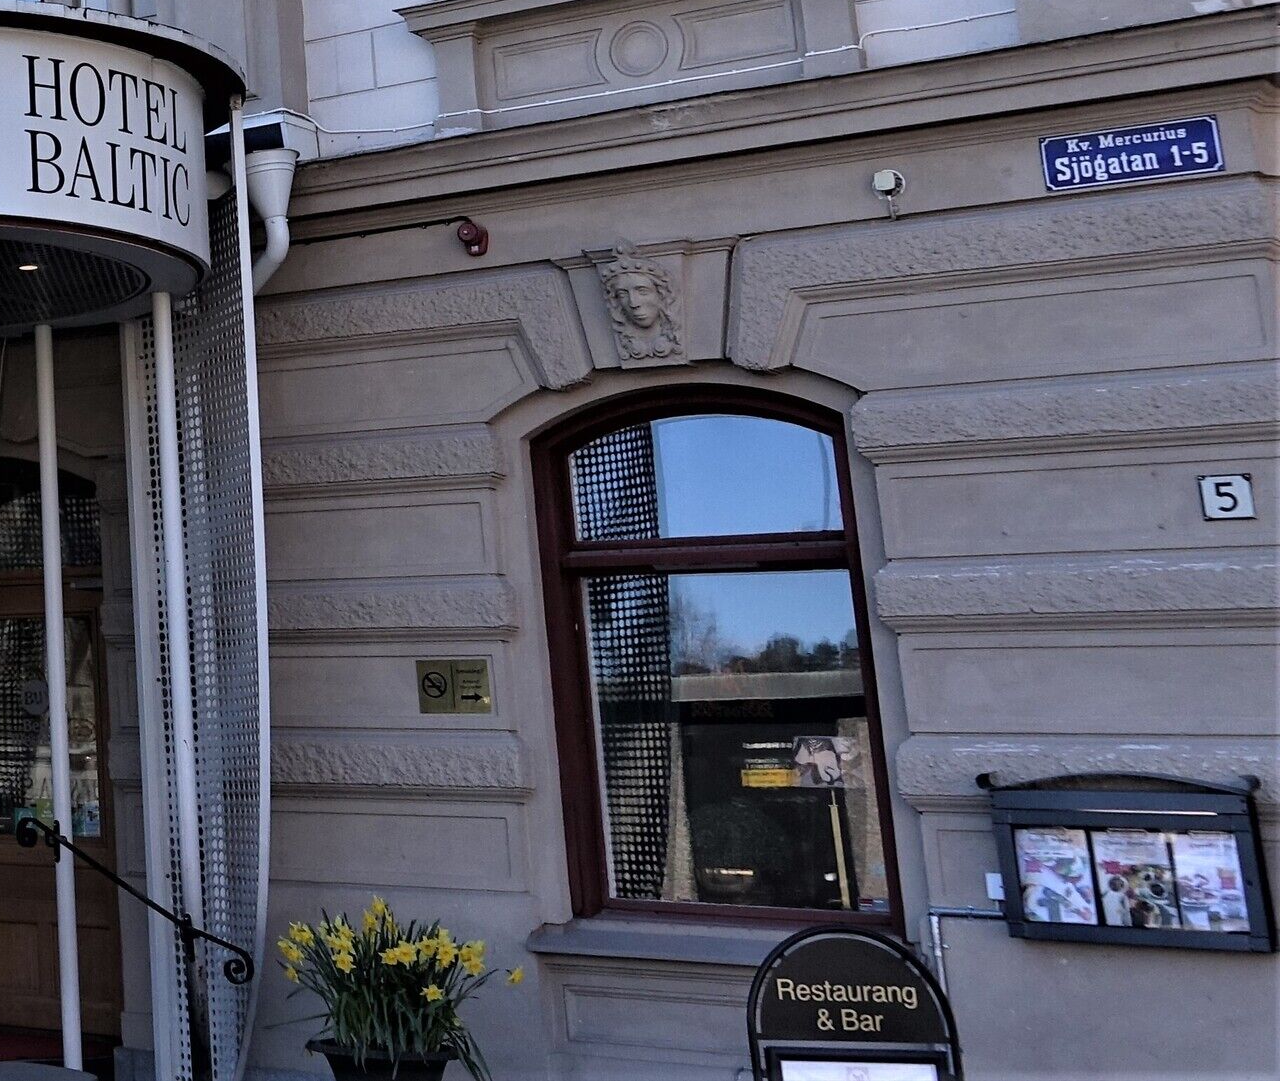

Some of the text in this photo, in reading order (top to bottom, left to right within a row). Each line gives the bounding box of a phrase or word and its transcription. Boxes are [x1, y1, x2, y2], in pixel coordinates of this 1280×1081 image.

[22, 54, 187, 154] HOTEL
[1066, 127, 1187, 153] Kv. Mercurius
[1054, 141, 1209, 182] Sjögatan 1-5
[24, 129, 190, 226] BALTIC
[1214, 482, 1238, 512] 5
[776, 978, 918, 1009] Restaurang
[817, 1008, 884, 1032] & Bar
